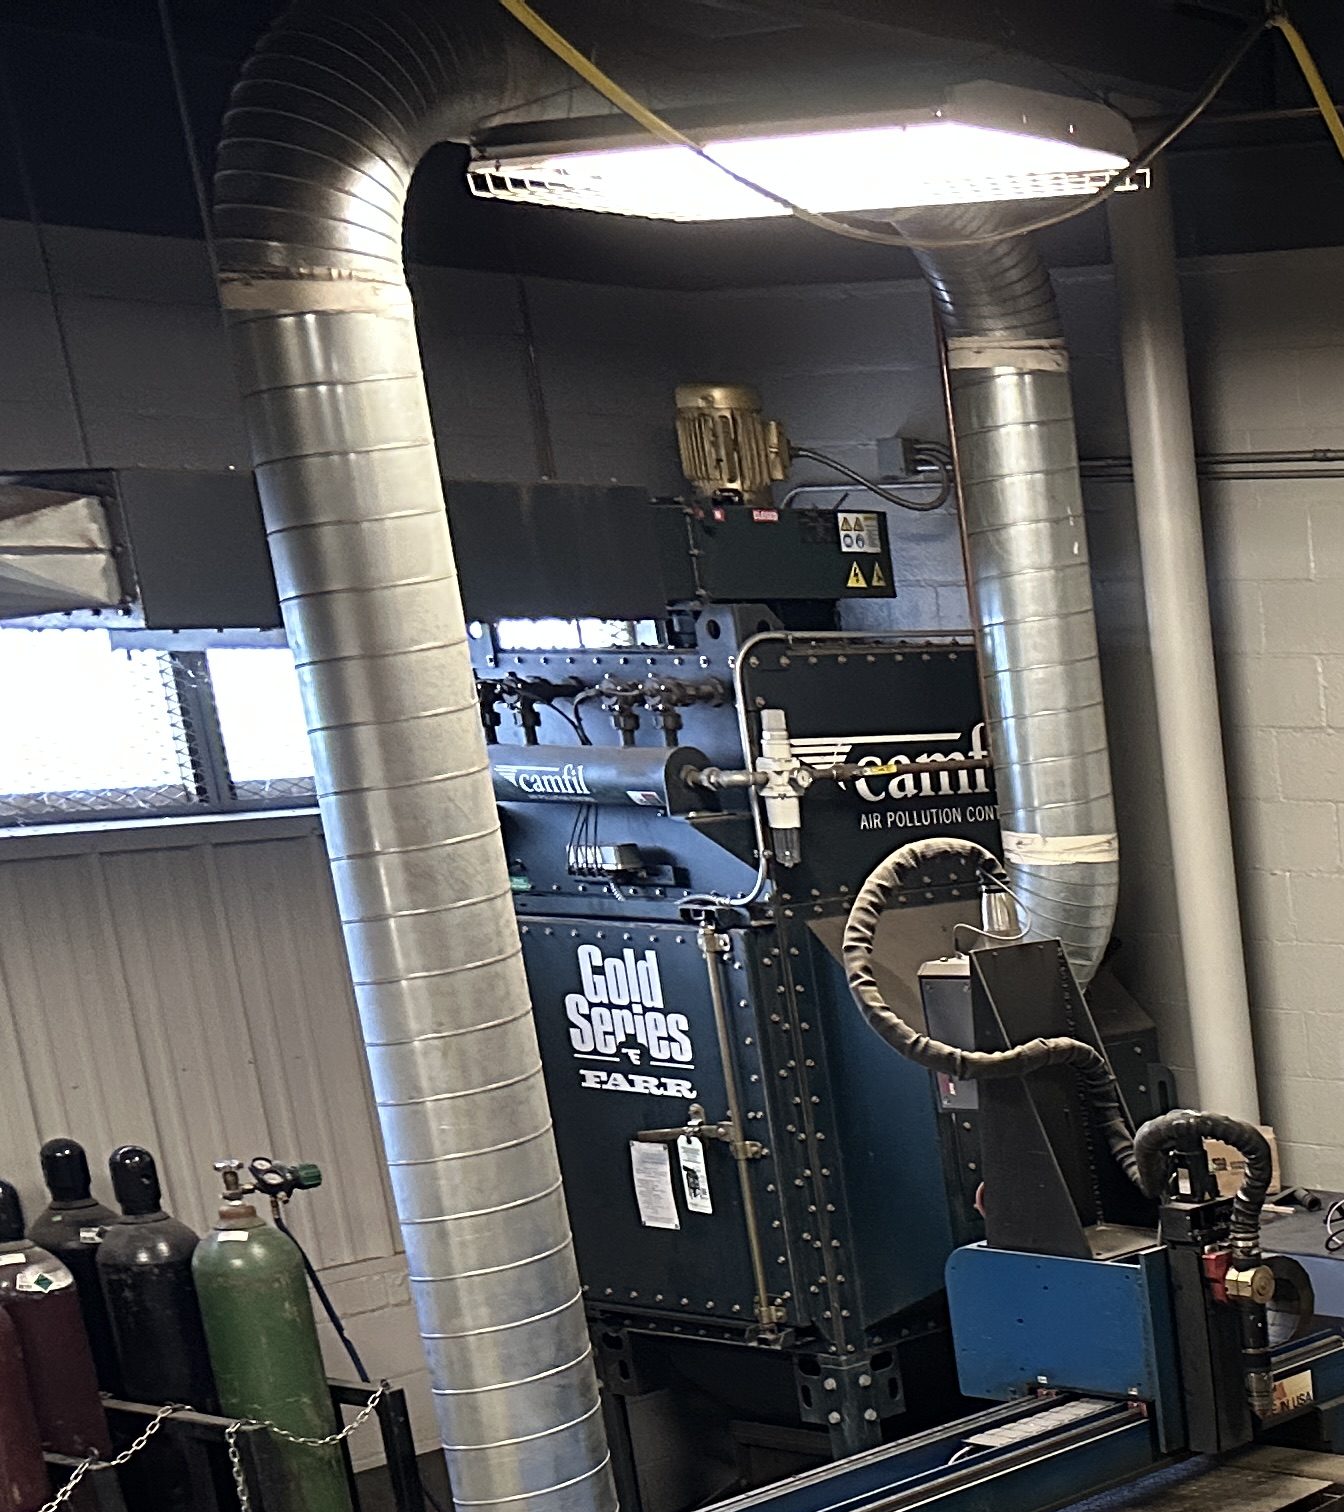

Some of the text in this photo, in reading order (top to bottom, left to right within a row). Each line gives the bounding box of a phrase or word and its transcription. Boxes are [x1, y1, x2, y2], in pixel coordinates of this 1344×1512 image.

[519, 764, 590, 795] camfil
[860, 813, 882, 830] AIR
[887, 807, 962, 827] POLLUTION
[577, 944, 664, 1009] Gold
[565, 993, 693, 1062] Series
[579, 1069, 698, 1099] FARR
[1293, 1391, 1313, 1408] USA
